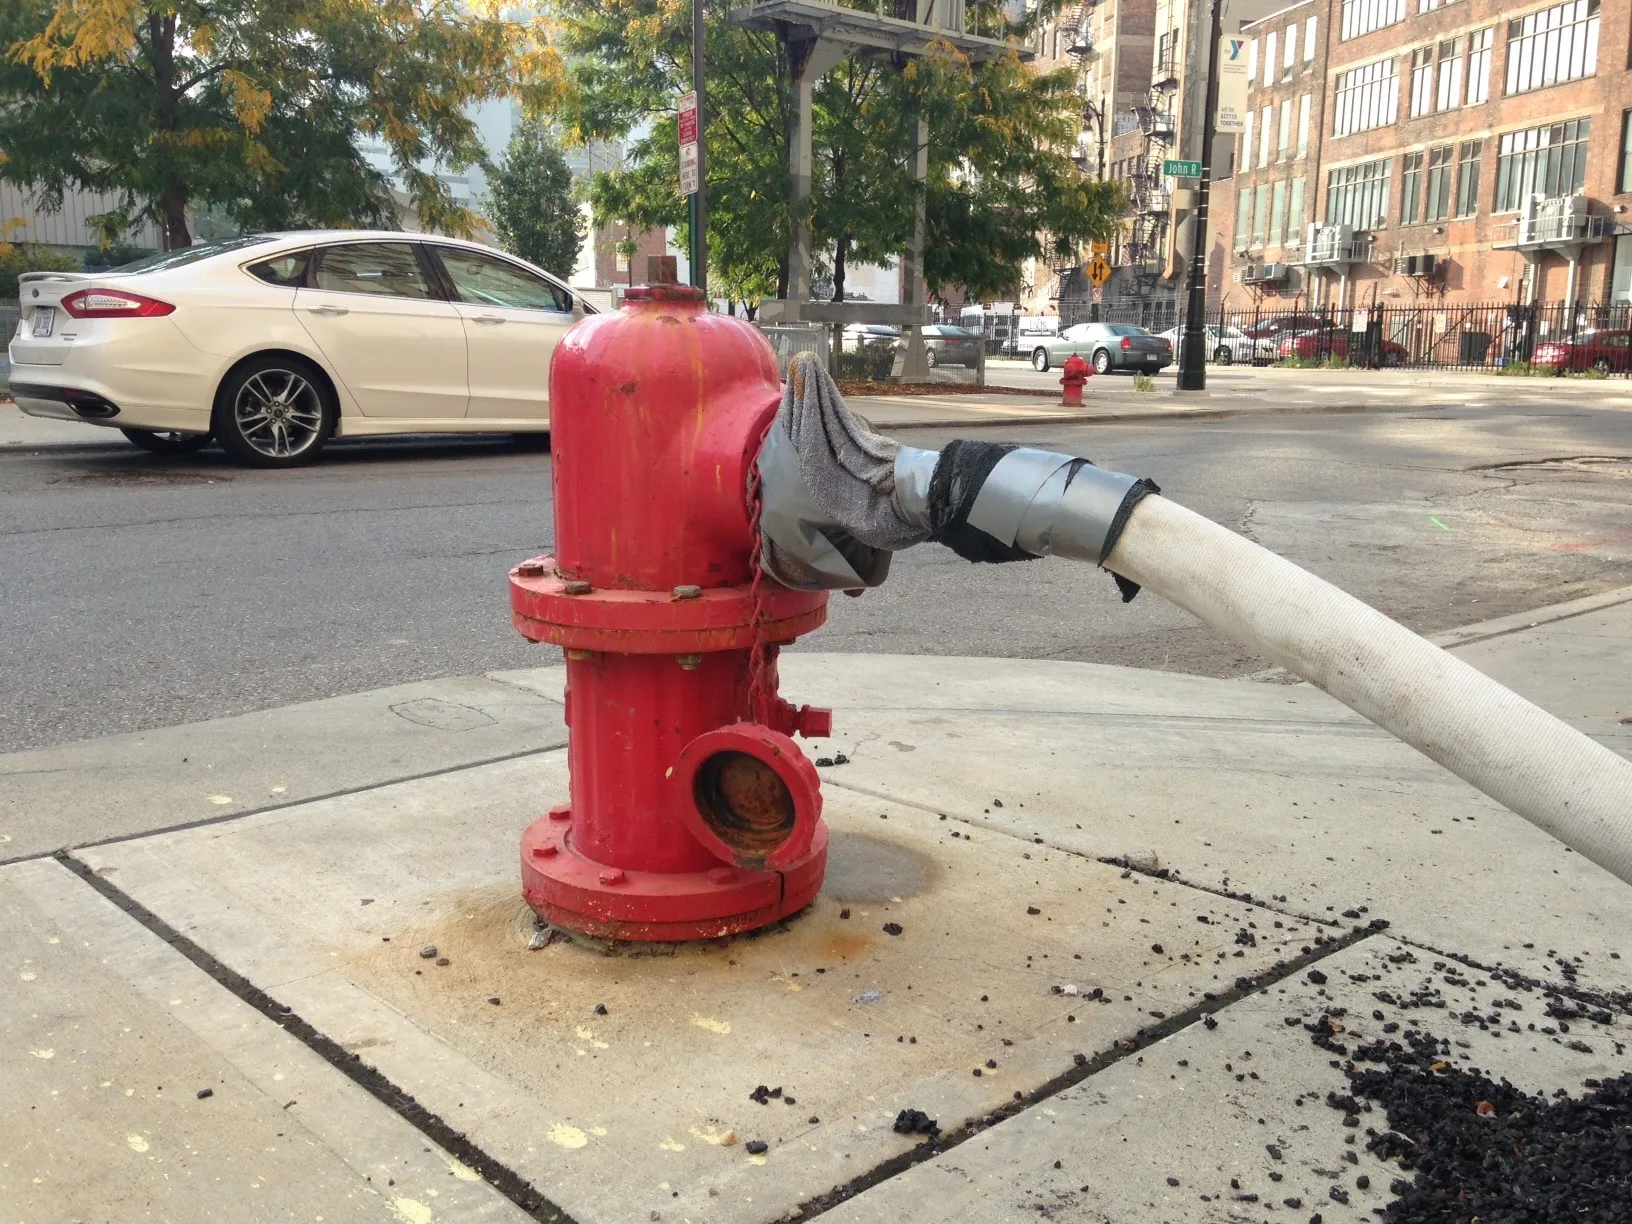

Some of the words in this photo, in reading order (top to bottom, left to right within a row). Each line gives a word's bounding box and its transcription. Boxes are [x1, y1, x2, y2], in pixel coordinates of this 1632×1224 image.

[682, 158, 696, 168] STANDING
[1168, 162, 1188, 175] John
[1191, 163, 1197, 175] R
